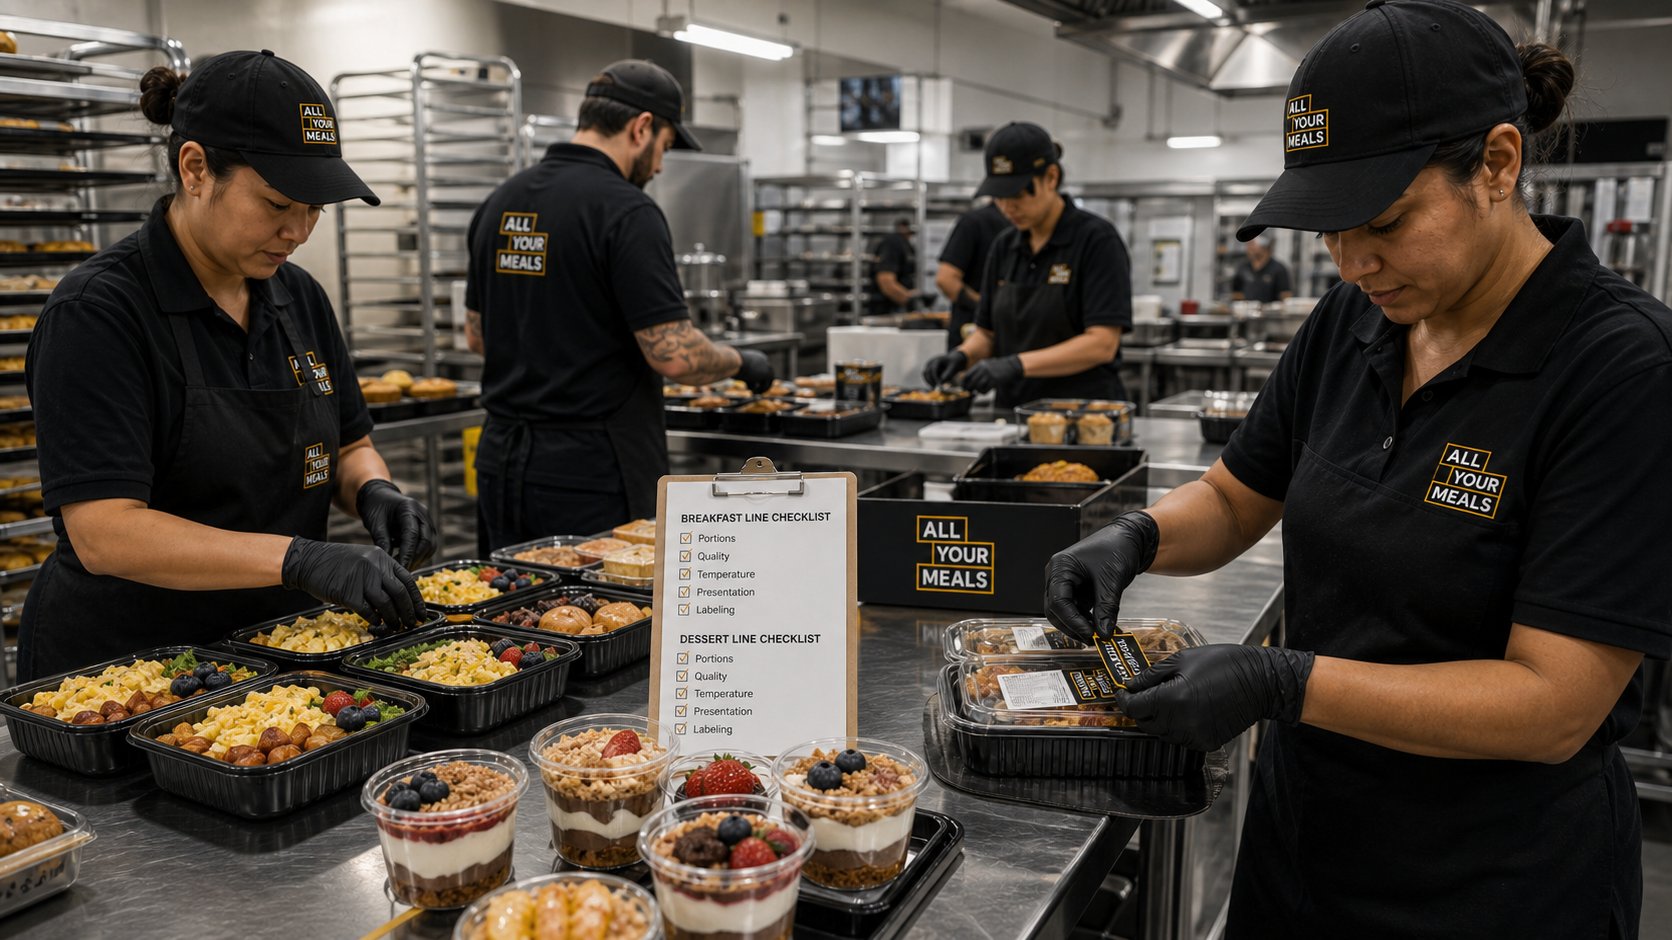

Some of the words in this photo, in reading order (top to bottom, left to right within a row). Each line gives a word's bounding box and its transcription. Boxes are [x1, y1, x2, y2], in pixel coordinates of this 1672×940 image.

[304, 106, 323, 116] ALL
[1289, 99, 1307, 114] ALL
[1294, 113, 1324, 130] YOUR
[306, 131, 336, 141] MEALS
[1288, 131, 1324, 148] MEALS
[504, 216, 531, 232] ALL
[512, 235, 545, 251] YOUR
[500, 254, 543, 271] MEALS
[1446, 449, 1480, 468] ALL
[1454, 470, 1500, 493] YOUR
[1431, 486, 1492, 512] MEALS
[681, 513, 742, 523] BREAKFAST
[745, 513, 769, 522] LINE
[772, 512, 831, 522] CHECKLIST
[923, 521, 960, 538] ALL
[698, 534, 736, 543] Portions
[697, 552, 730, 562] Quality
[936, 546, 989, 564] YOUR
[697, 570, 756, 581] Temperature
[922, 569, 988, 589] MEALS
[697, 588, 755, 597] Presentation
[696, 605, 735, 616] Labeling
[680, 634, 729, 644] DESSERT
[732, 634, 757, 644] LINE
[760, 634, 821, 643] CHECKLIST
[695, 654, 734, 663] Portions
[694, 672, 728, 682] Quality
[694, 689, 754, 700] Temperature
[693, 707, 753, 716] Presentation
[693, 725, 733, 736] Labeling
